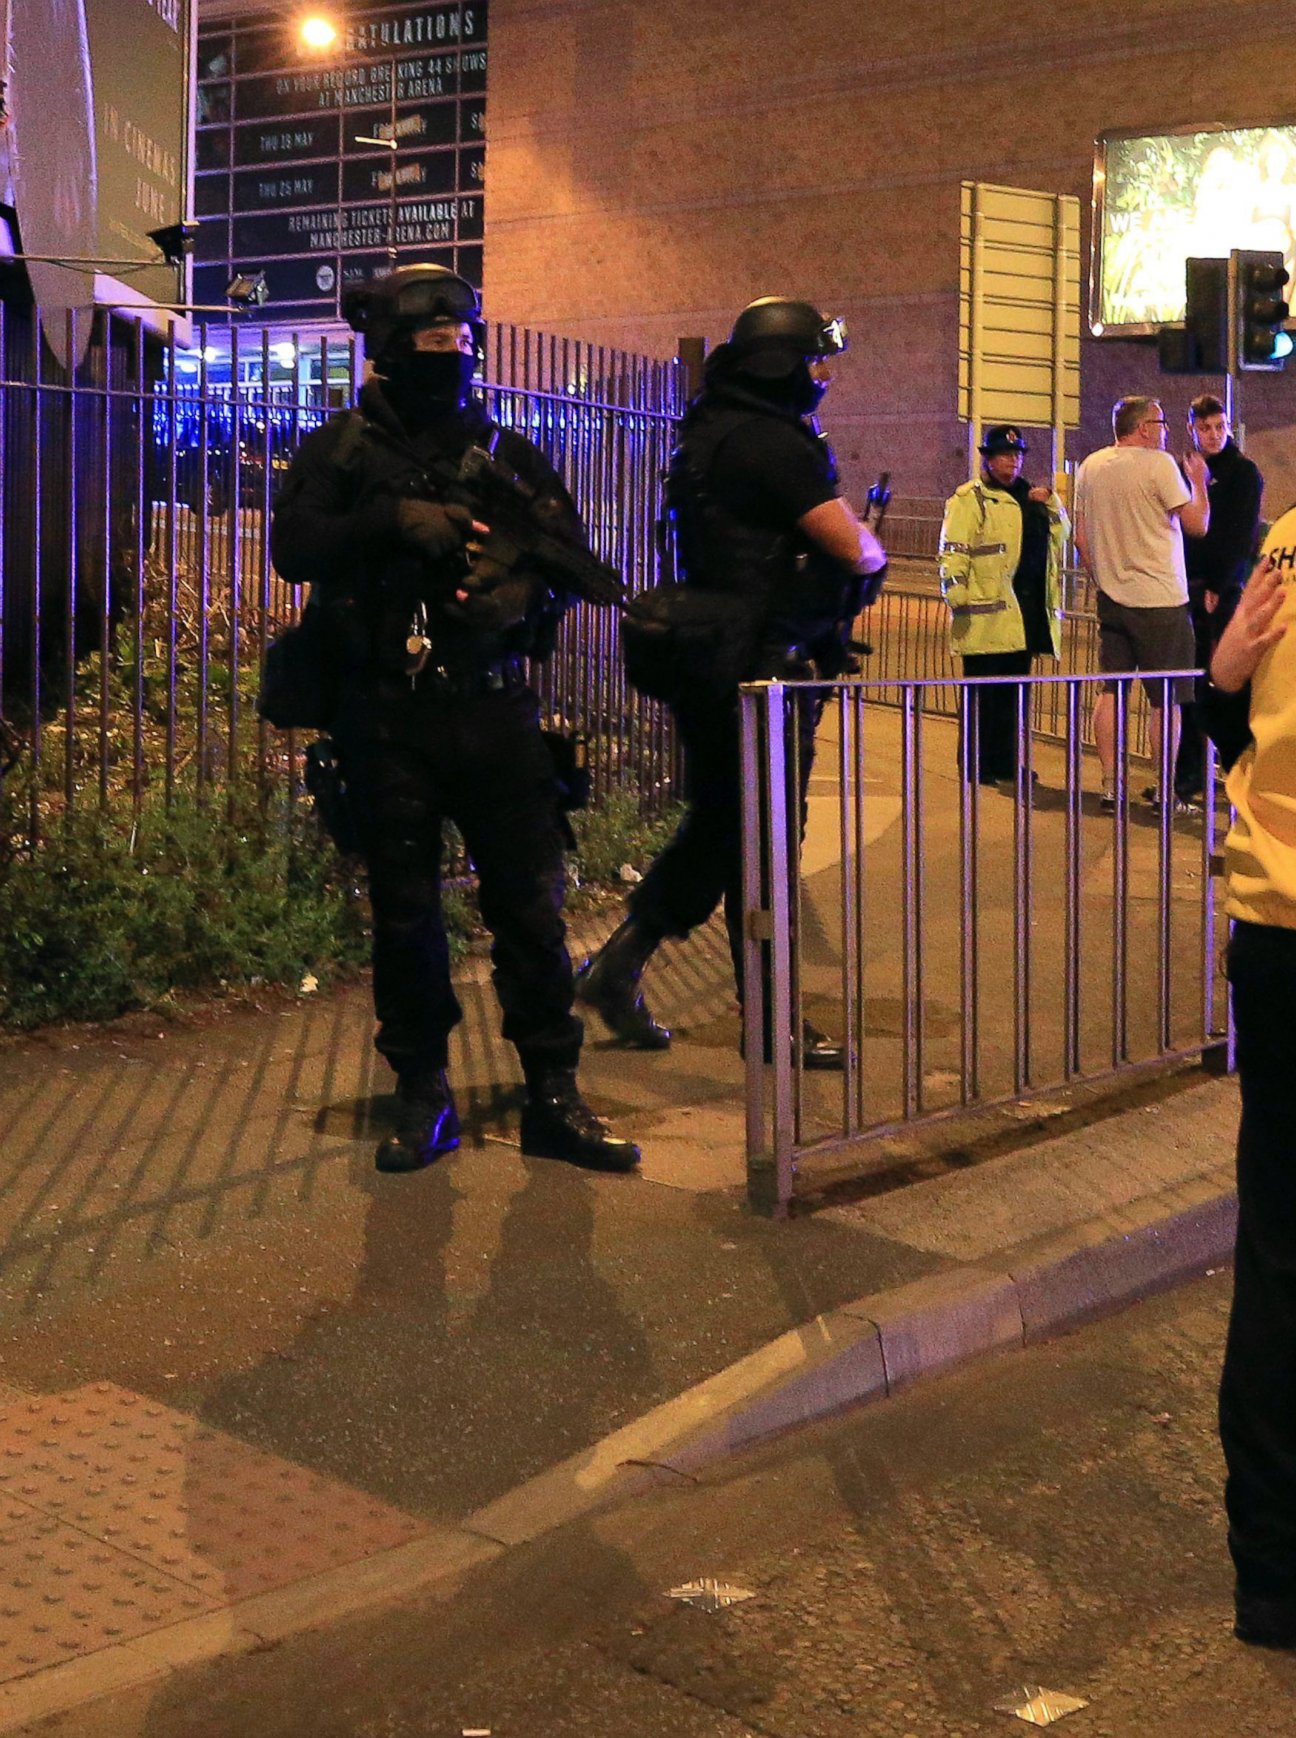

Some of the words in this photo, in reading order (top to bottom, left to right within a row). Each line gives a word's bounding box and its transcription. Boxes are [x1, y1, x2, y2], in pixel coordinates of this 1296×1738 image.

[345, 10, 475, 50] RATULATIONS
[370, 61, 423, 83] BREKING
[428, 58, 442, 76] 44
[445, 52, 487, 74] SOWS
[334, 82, 405, 106] MANCHESTR
[407, 76, 443, 97] ARENA
[125, 120, 176, 187] CINEMAS
[288, 212, 349, 232] REMAINING
[351, 208, 393, 226] TICKETS
[398, 202, 458, 223] AVAILABLE
[461, 200, 475, 218] AT
[1109, 211, 1142, 234] WE
